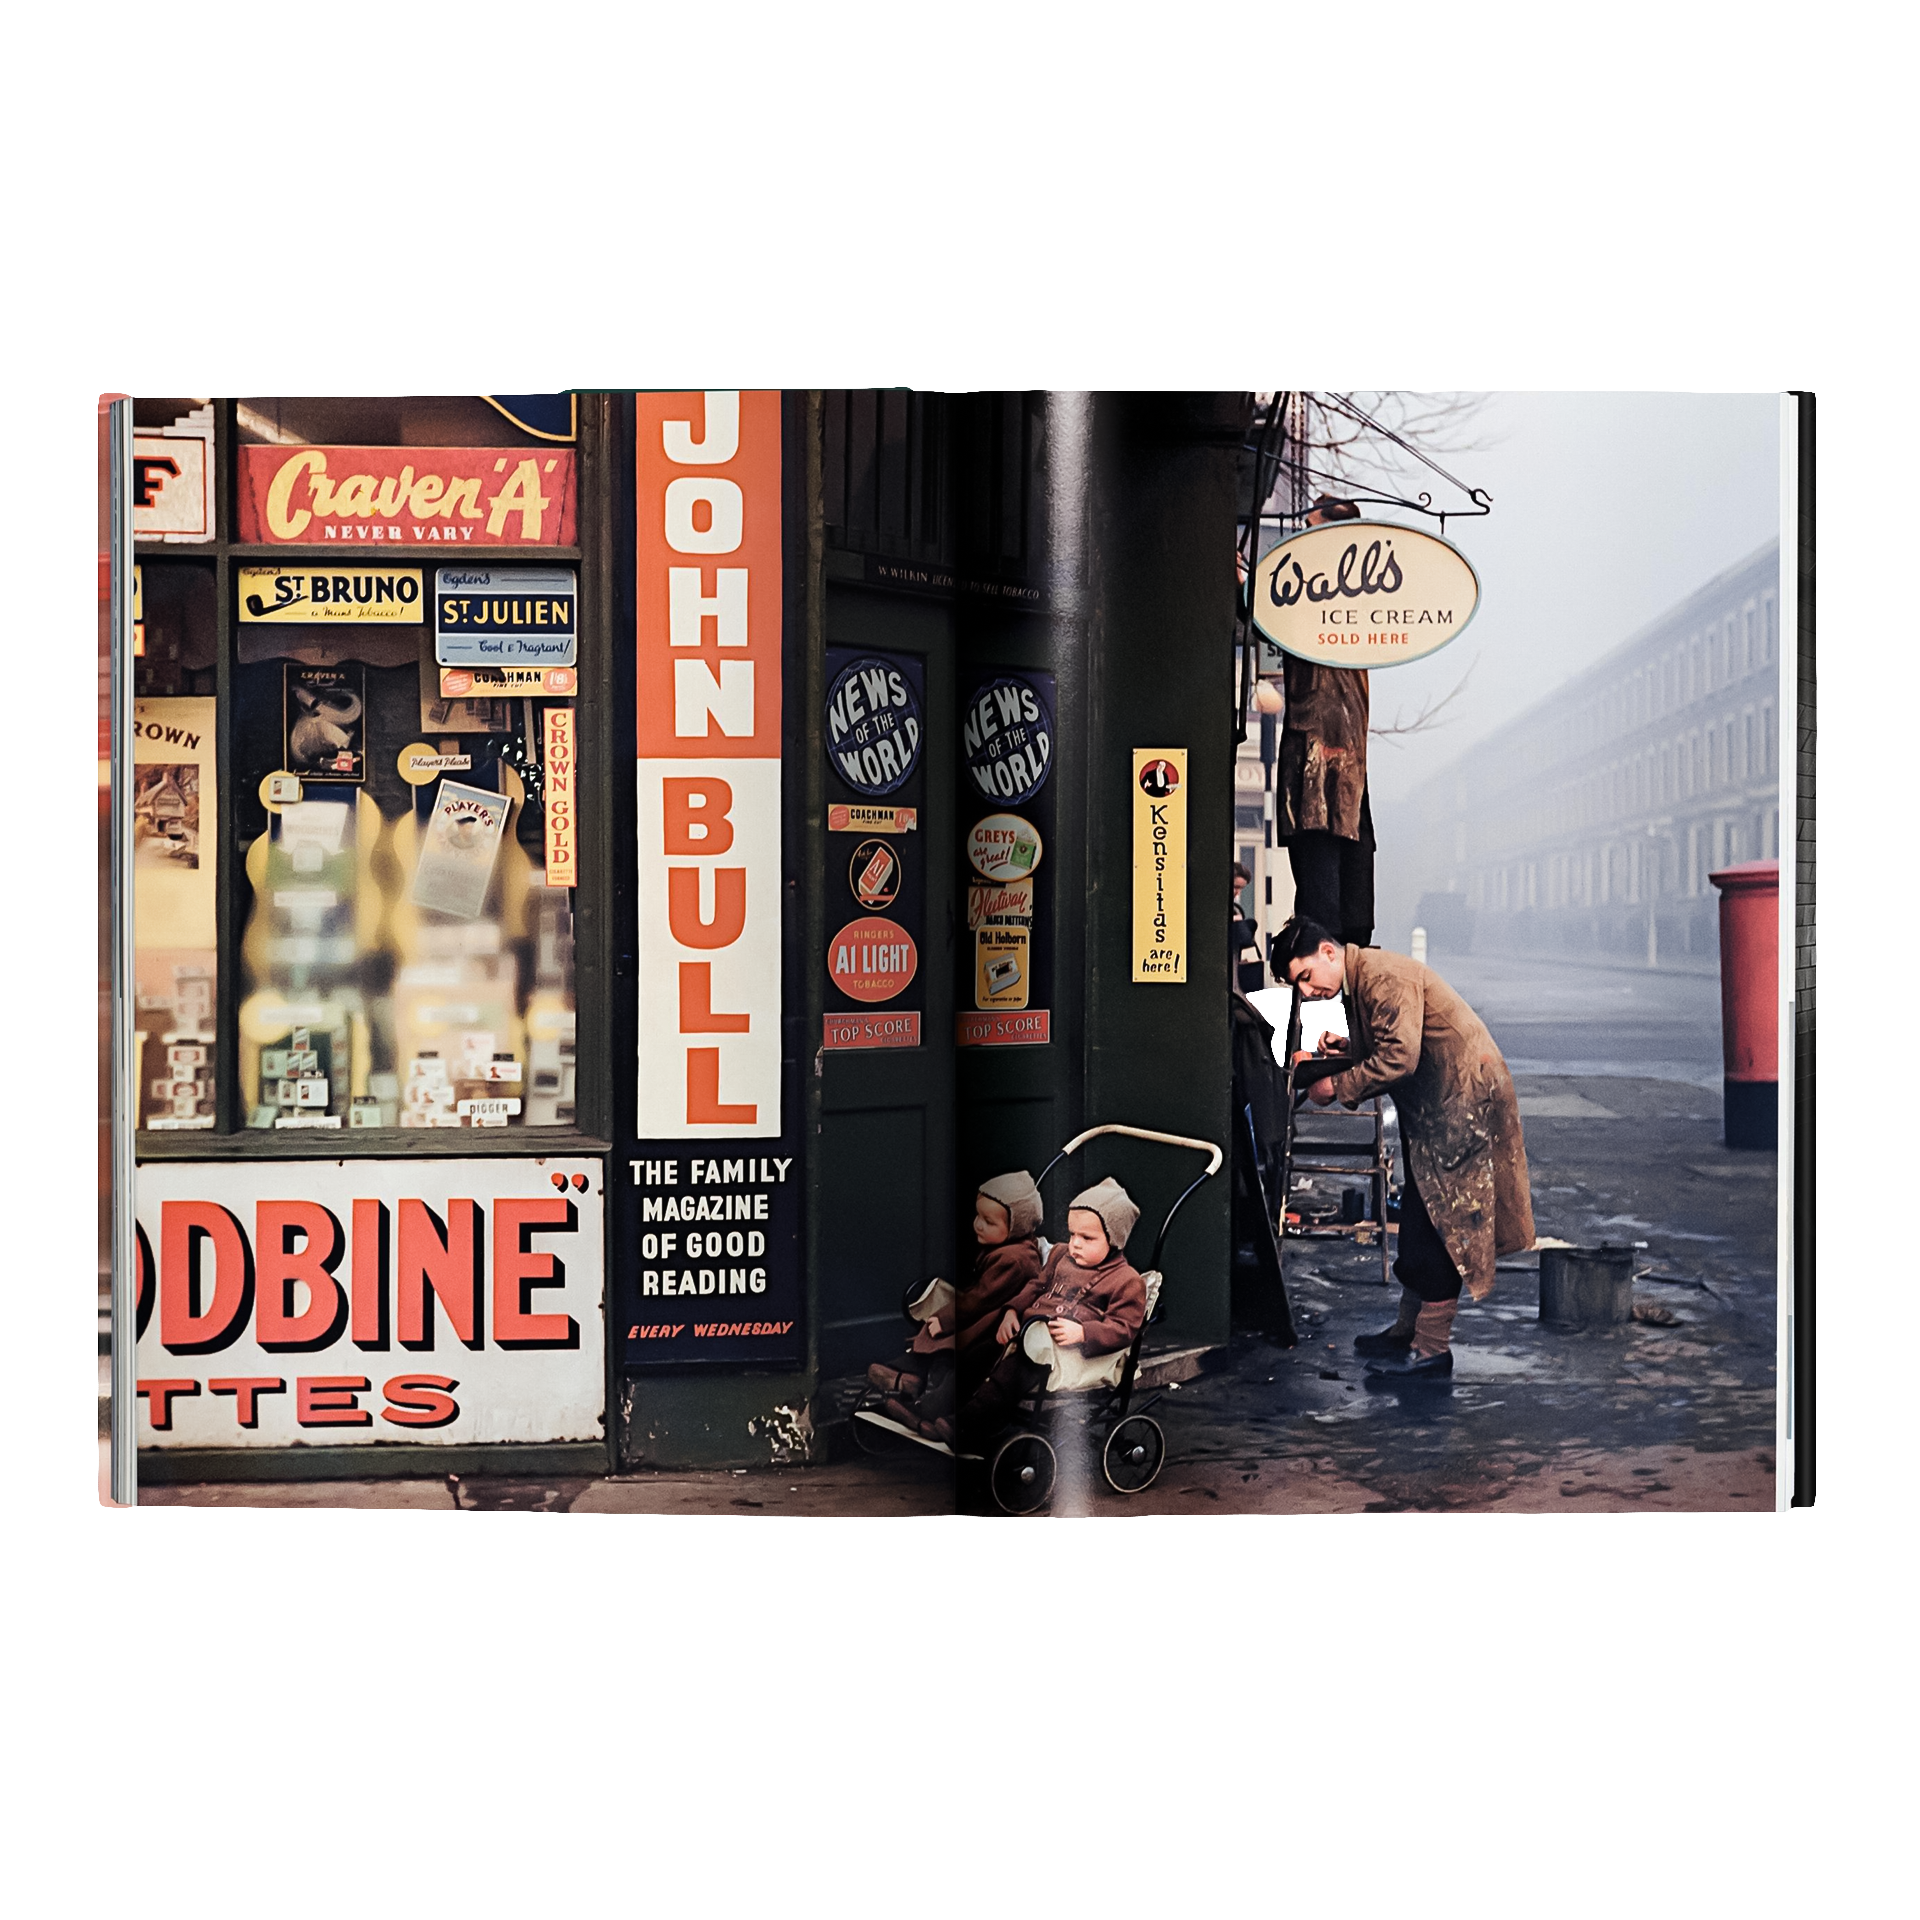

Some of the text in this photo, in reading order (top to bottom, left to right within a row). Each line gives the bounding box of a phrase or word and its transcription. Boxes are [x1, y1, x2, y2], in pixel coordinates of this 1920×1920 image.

[266, 450, 559, 541] Craven 'A'
[324, 525, 475, 541] NEVER VARY
[662, 391, 755, 737] JOHN
[1269, 539, 1403, 607] Wall's
[311, 576, 418, 603] BRUNO
[443, 573, 490, 589] Ogden's
[890, 567, 928, 583] WILKIN
[1002, 585, 1040, 600] TOBACCO
[473, 600, 569, 624] JULIEN
[1321, 609, 1453, 625] ICE CREAM
[478, 640, 503, 654] Cool
[1318, 633, 1409, 645] SOLD HERE
[474, 671, 541, 683] COHMAN
[830, 668, 907, 744] NEWS
[855, 712, 894, 744] OF THE
[964, 686, 1039, 758] NEWS
[838, 717, 919, 786] WORLD
[988, 727, 1026, 758] OF THE
[972, 731, 1050, 797] WORLD
[549, 713, 570, 864] CROWN GOLD
[444, 800, 494, 827] PLAYER'S
[850, 808, 894, 820] COACHMAN
[975, 829, 1015, 844] GREYS
[973, 847, 987, 857] are
[1150, 804, 1168, 943] Kensitas
[853, 930, 894, 939] RINGERS
[980, 931, 1026, 945] Old Holborn
[662, 777, 757, 1124] BULL
[862, 944, 909, 973] LIGHT
[1142, 953, 1180, 974] here!
[1150, 949, 1173, 960] are
[853, 979, 895, 989] TOBACCO
[831, 1017, 912, 1044] TOP SCORE
[964, 1015, 1042, 1040] TOP SCORE
[470, 1103, 508, 1114] DIGGER
[629, 1158, 793, 1185] THE FAMILY
[642, 1194, 769, 1222] MAGAZINE
[642, 1231, 765, 1259] OF GOOD
[643, 1267, 766, 1296] READING
[627, 1321, 794, 1339] EVERY WEDNESDAY
[136, 1374, 460, 1431] TTES
